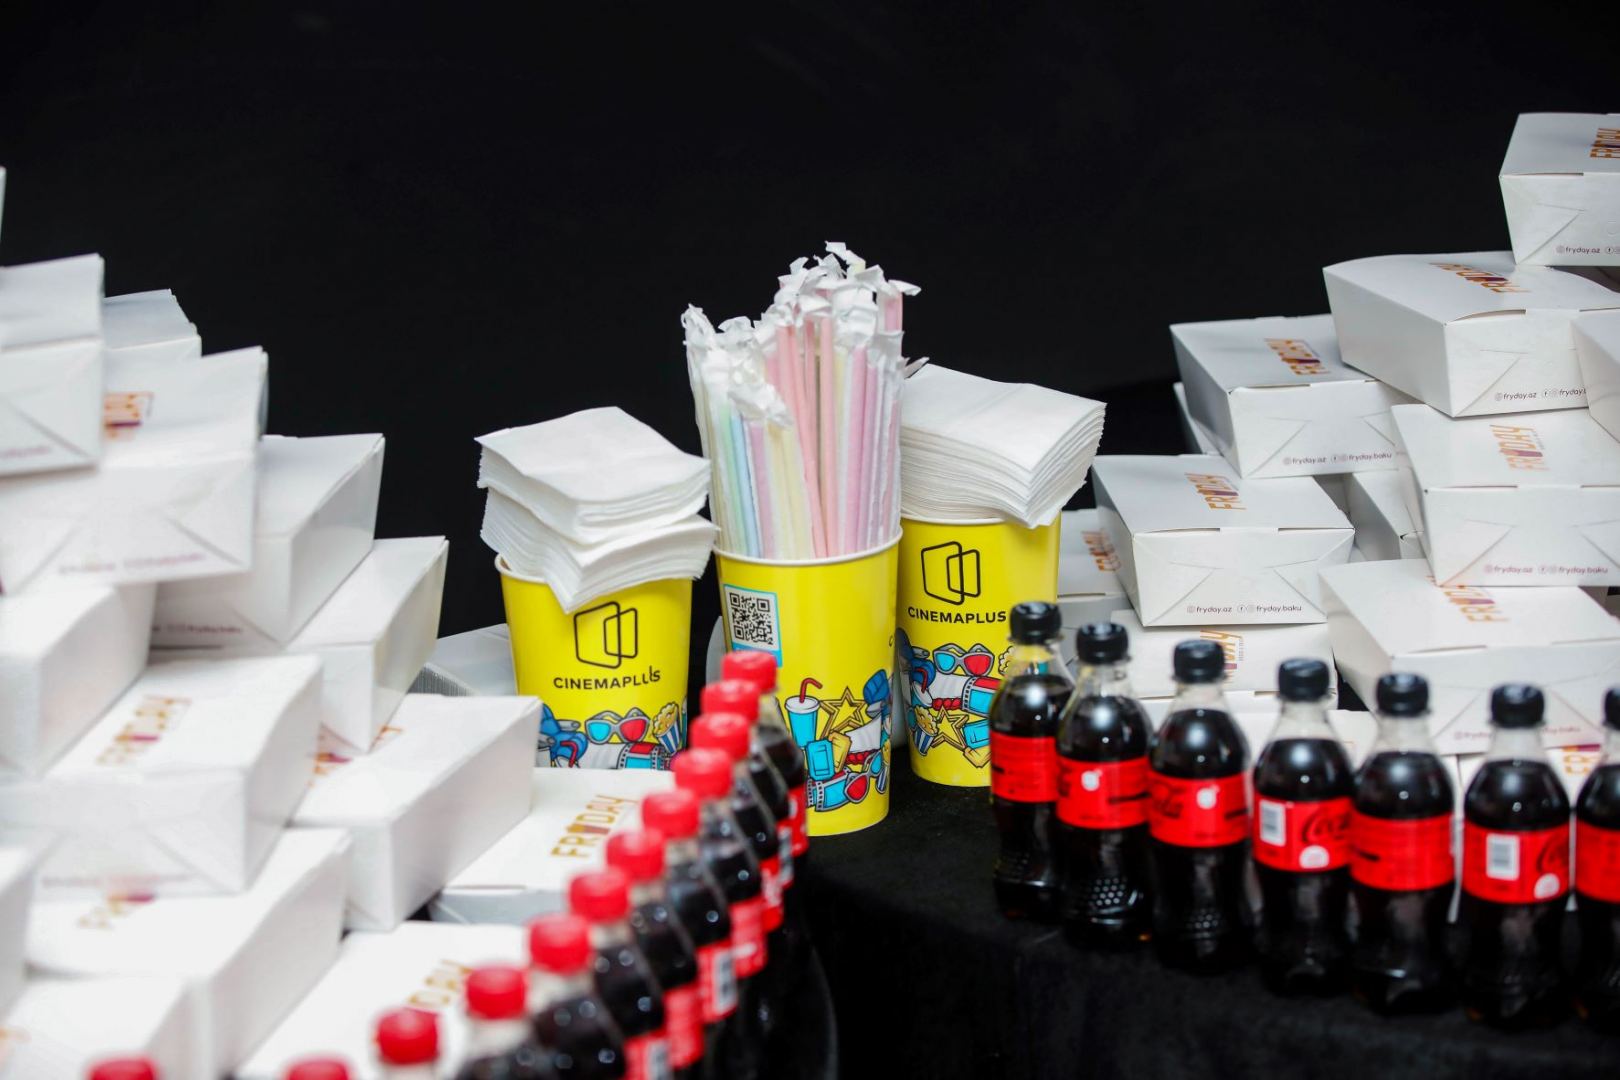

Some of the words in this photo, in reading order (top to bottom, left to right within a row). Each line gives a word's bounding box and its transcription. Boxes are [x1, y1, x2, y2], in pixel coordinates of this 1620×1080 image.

[1565, 246, 1601, 255] fryday.az
[1503, 392, 1537, 400] fryday.az
[1292, 456, 1327, 465] fryday.az
[1347, 451, 1392, 463] fryday.baku
[1196, 605, 1233, 614] fryday.az
[1256, 604, 1302, 613] fryday.baku
[907, 606, 1006, 624] CINEMAPLUS
